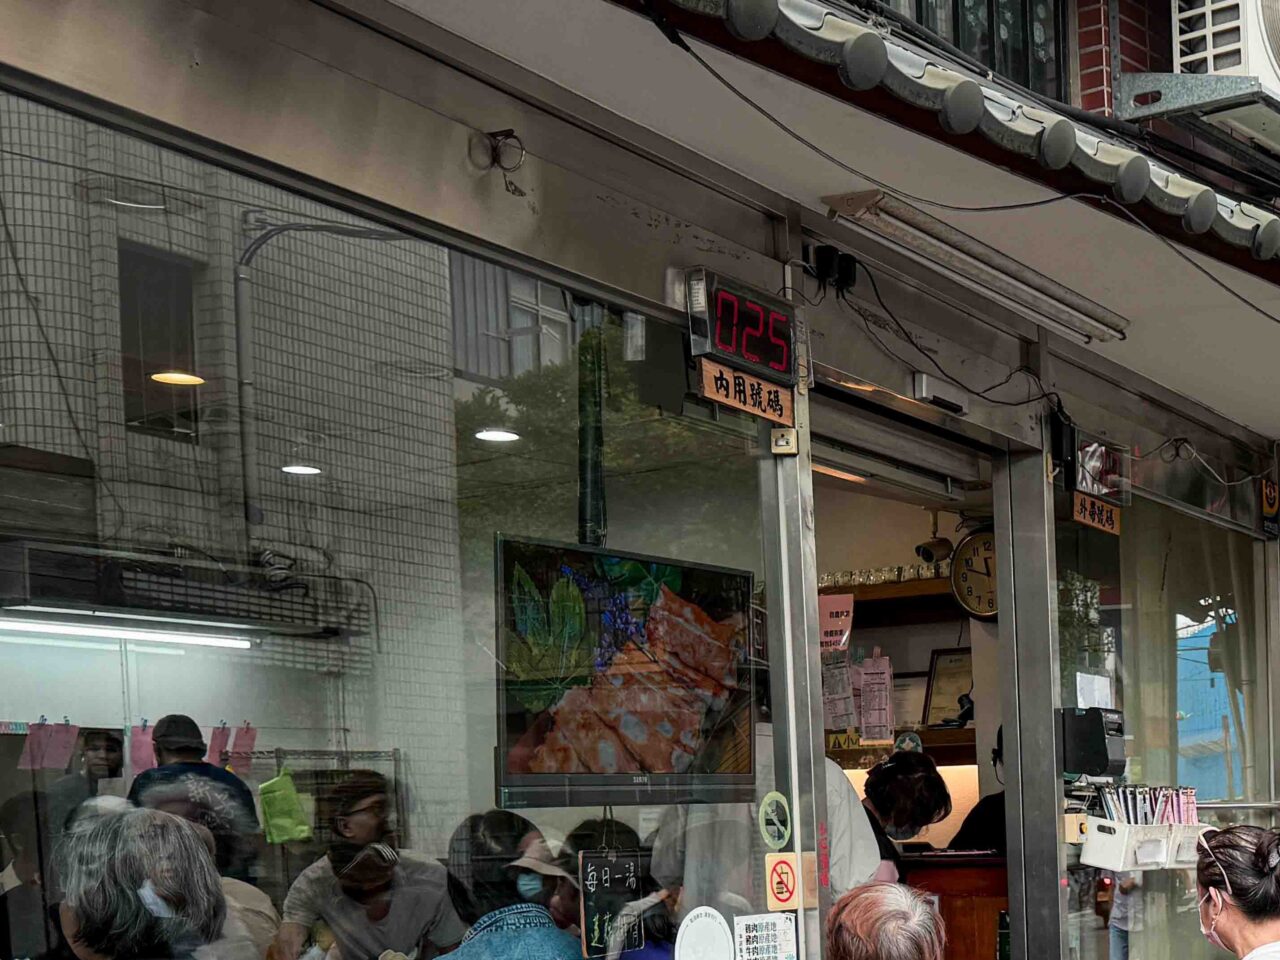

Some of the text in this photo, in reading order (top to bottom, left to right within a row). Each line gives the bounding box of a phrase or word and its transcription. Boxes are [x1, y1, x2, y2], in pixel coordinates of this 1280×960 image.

[715, 290, 789, 371] 025
[714, 369, 784, 417] 內用號碼
[585, 862, 636, 893] 每日一湯
